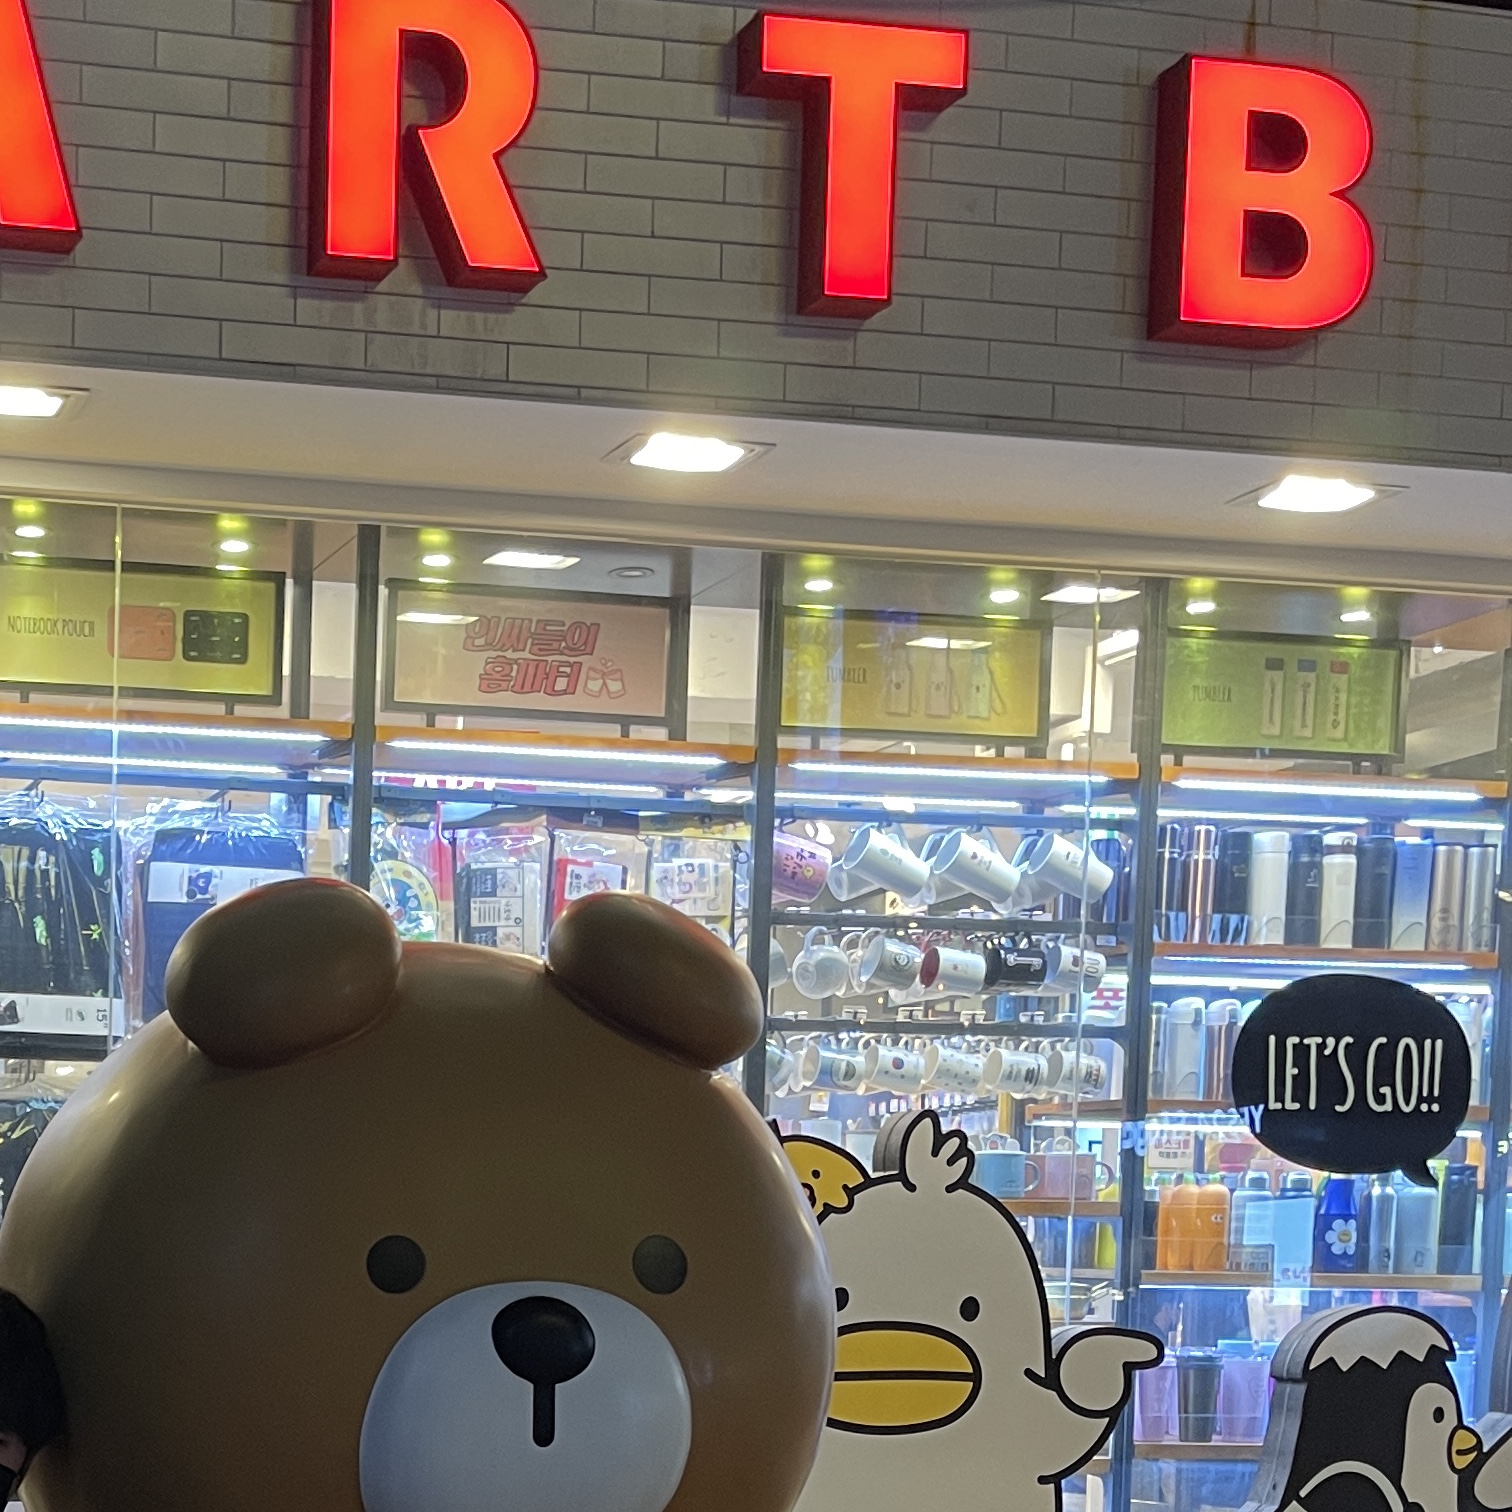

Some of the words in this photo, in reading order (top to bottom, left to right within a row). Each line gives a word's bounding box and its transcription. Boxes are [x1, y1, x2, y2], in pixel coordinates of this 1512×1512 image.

[7, 615, 60, 636] NOTEBOOK
[61, 618, 95, 638] POUCH
[463, 614, 600, 657] 인싸들의
[478, 655, 582, 697] 홈파티
[826, 665, 868, 685] TUMBLER
[1191, 684, 1232, 703] TUMBLER
[1267, 1033, 1355, 1114] LET'S
[1365, 1035, 1443, 1114] GO!!
